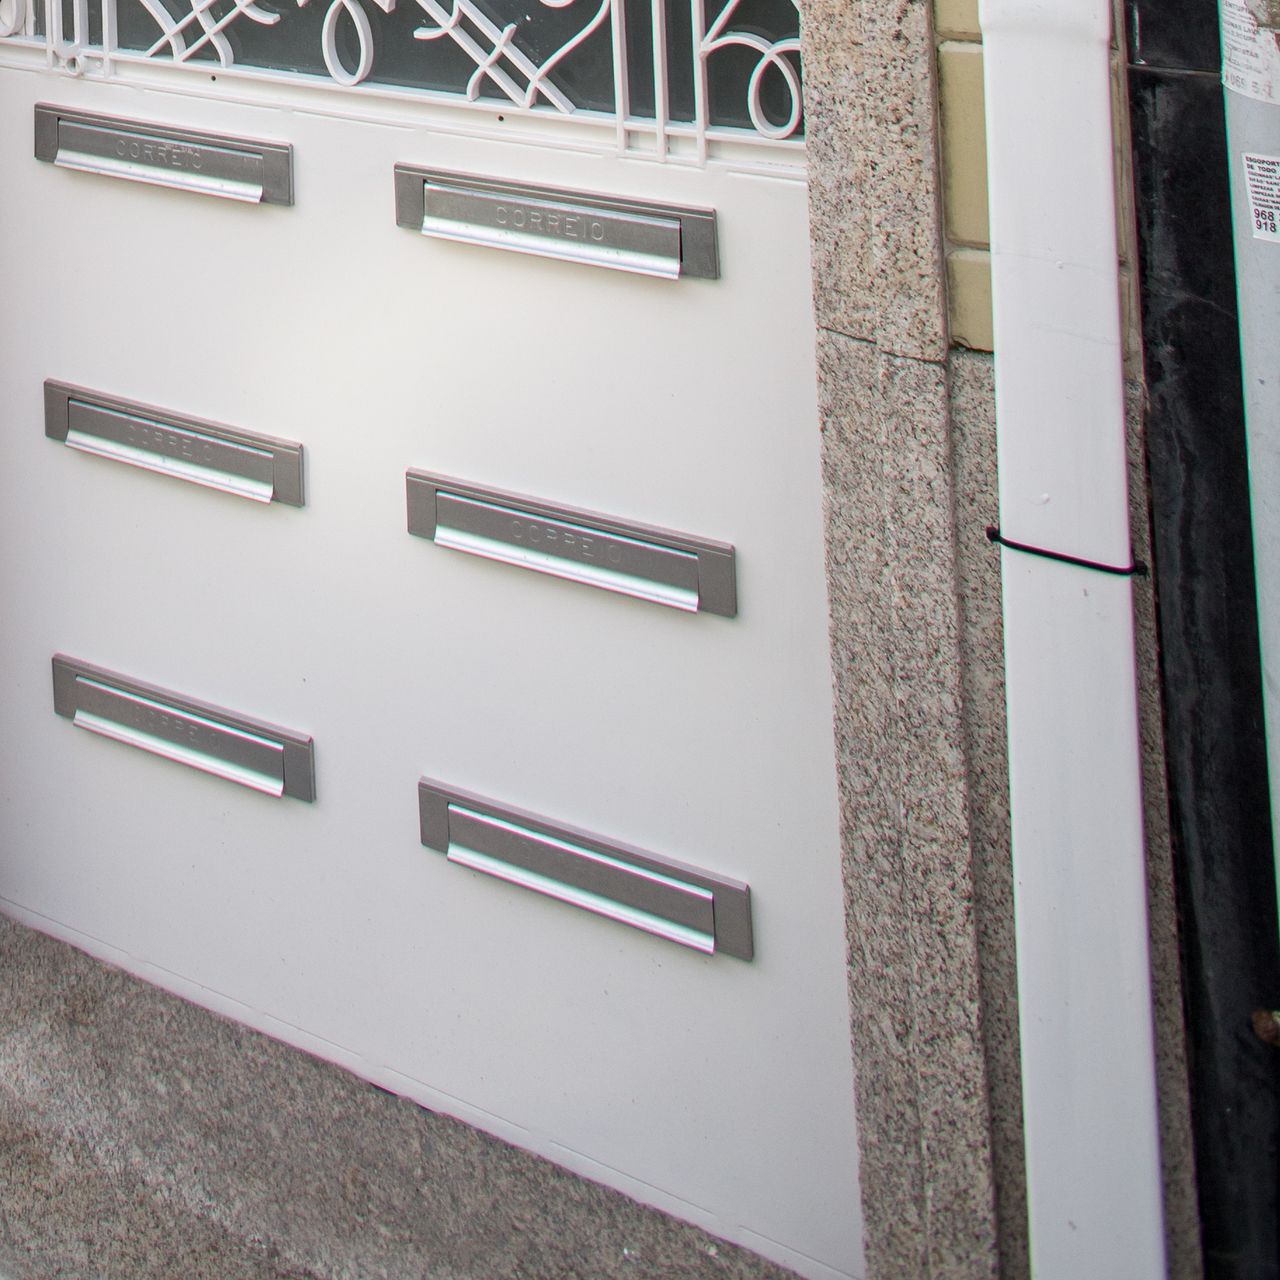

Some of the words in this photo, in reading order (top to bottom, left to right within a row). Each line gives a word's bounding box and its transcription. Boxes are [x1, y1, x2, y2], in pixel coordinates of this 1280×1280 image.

[116, 139, 202, 169] CORREIO
[1257, 165, 1277, 173] TODO
[495, 206, 605, 241] CORREIO
[1254, 208, 1274, 221] 968
[1256, 220, 1277, 232] 918
[512, 520, 622, 563] CORREO
